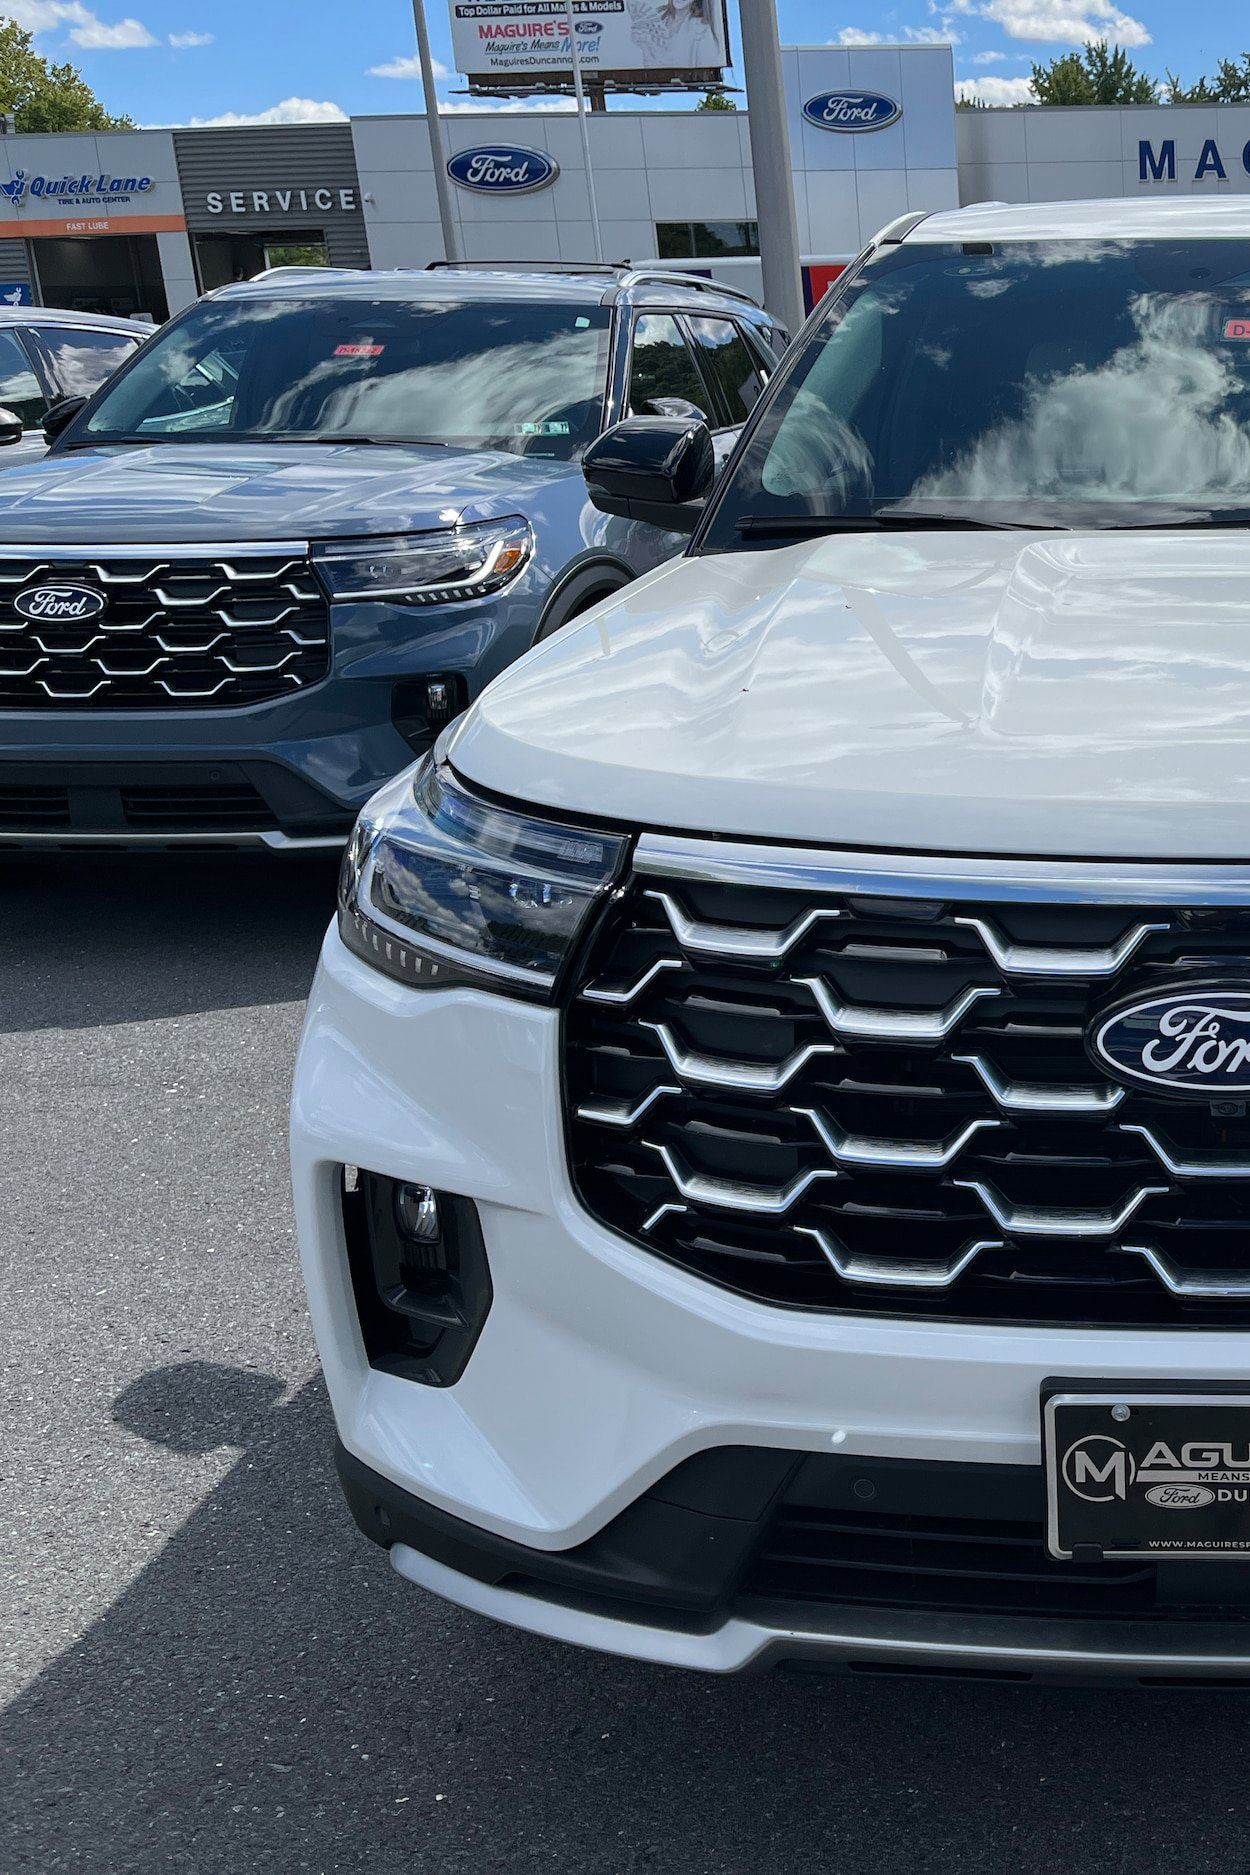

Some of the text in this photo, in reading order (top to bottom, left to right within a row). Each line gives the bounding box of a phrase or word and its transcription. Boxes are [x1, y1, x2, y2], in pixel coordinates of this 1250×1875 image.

[458, 1, 622, 17] Top Dollar Paid for All Mas & Models
[478, 20, 570, 39] MAGUIRE'S
[486, 42, 527, 54] Maguire's
[531, 40, 560, 50] Means
[490, 56, 600, 67] MaguiresDuncanno.com
[822, 96, 877, 121] Ford
[467, 154, 529, 183] Ford
[30, 174, 151, 196] Quick Lane
[58, 198, 74, 206] TIRE
[81, 197, 101, 205] AUTO
[102, 196, 131, 204] CENTER
[206, 188, 357, 214] SERVICE
[66, 221, 109, 231] FAST LUBE
[28, 590, 87, 616] Ford
[1198, 1472, 1250, 1482] MEANS
[1159, 1485, 1201, 1504] Ford
